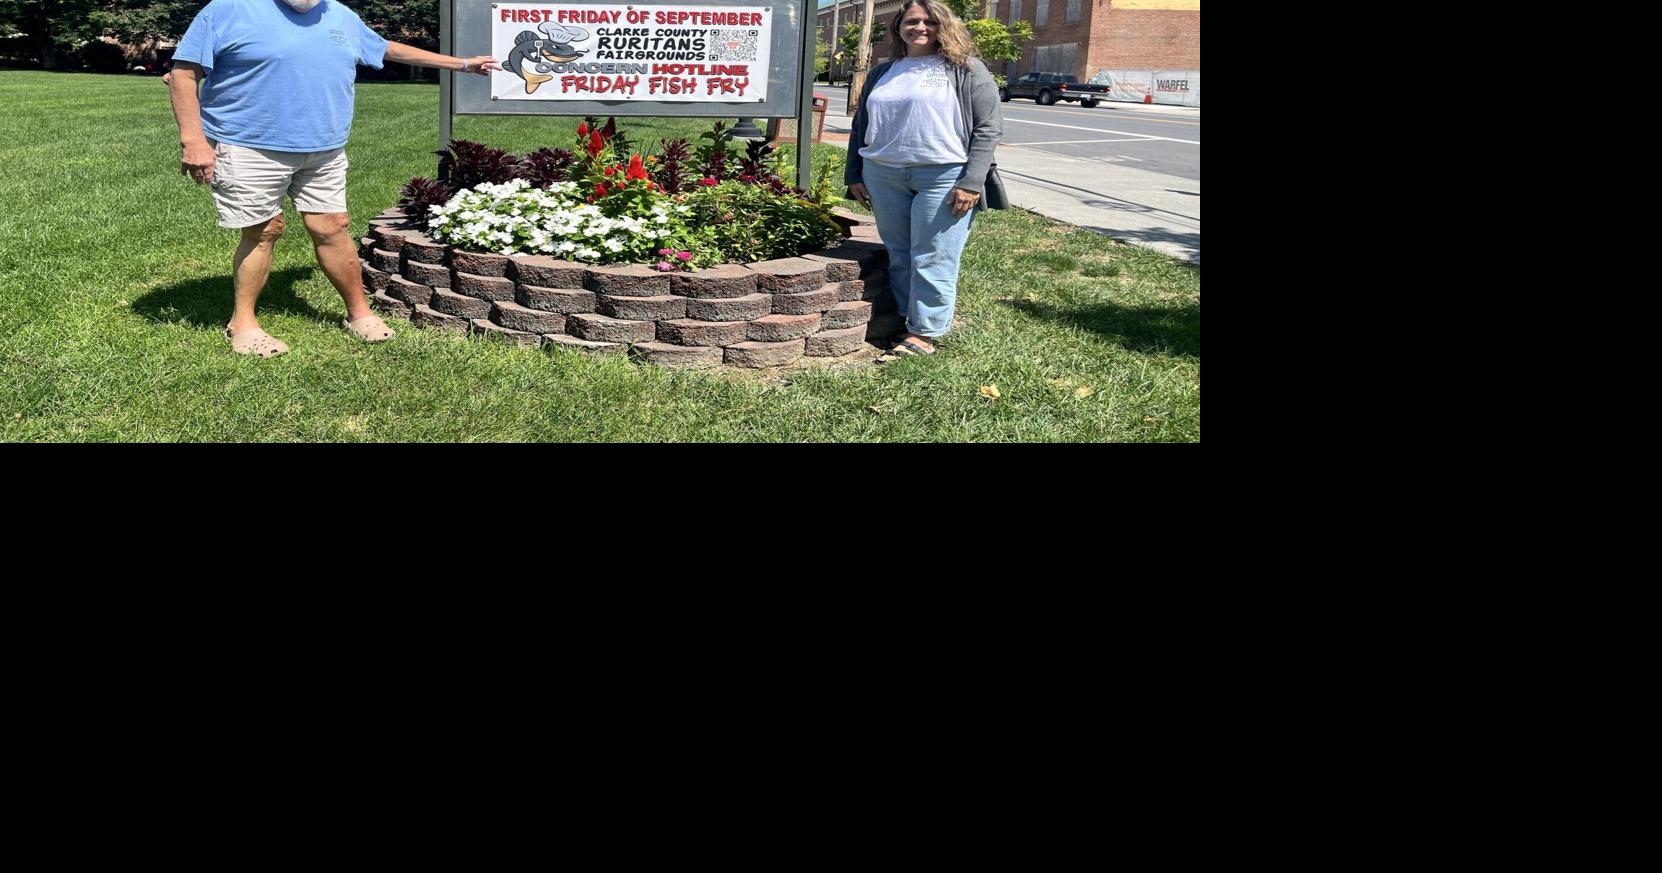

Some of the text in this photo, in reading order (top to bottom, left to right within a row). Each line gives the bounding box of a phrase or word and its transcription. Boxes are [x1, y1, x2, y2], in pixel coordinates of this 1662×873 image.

[501, 9, 762, 26] FIRST FRIDAY OF SEPTEMBER
[596, 28, 707, 37] CLARKE COUNTY
[597, 37, 705, 51] RURITANS
[596, 50, 705, 60] FAIRGROUNDS
[535, 62, 749, 76] CONCERN HOTLINE
[561, 75, 749, 96] FRIDAY FISH FRY
[1156, 80, 1189, 90] WARFEL
